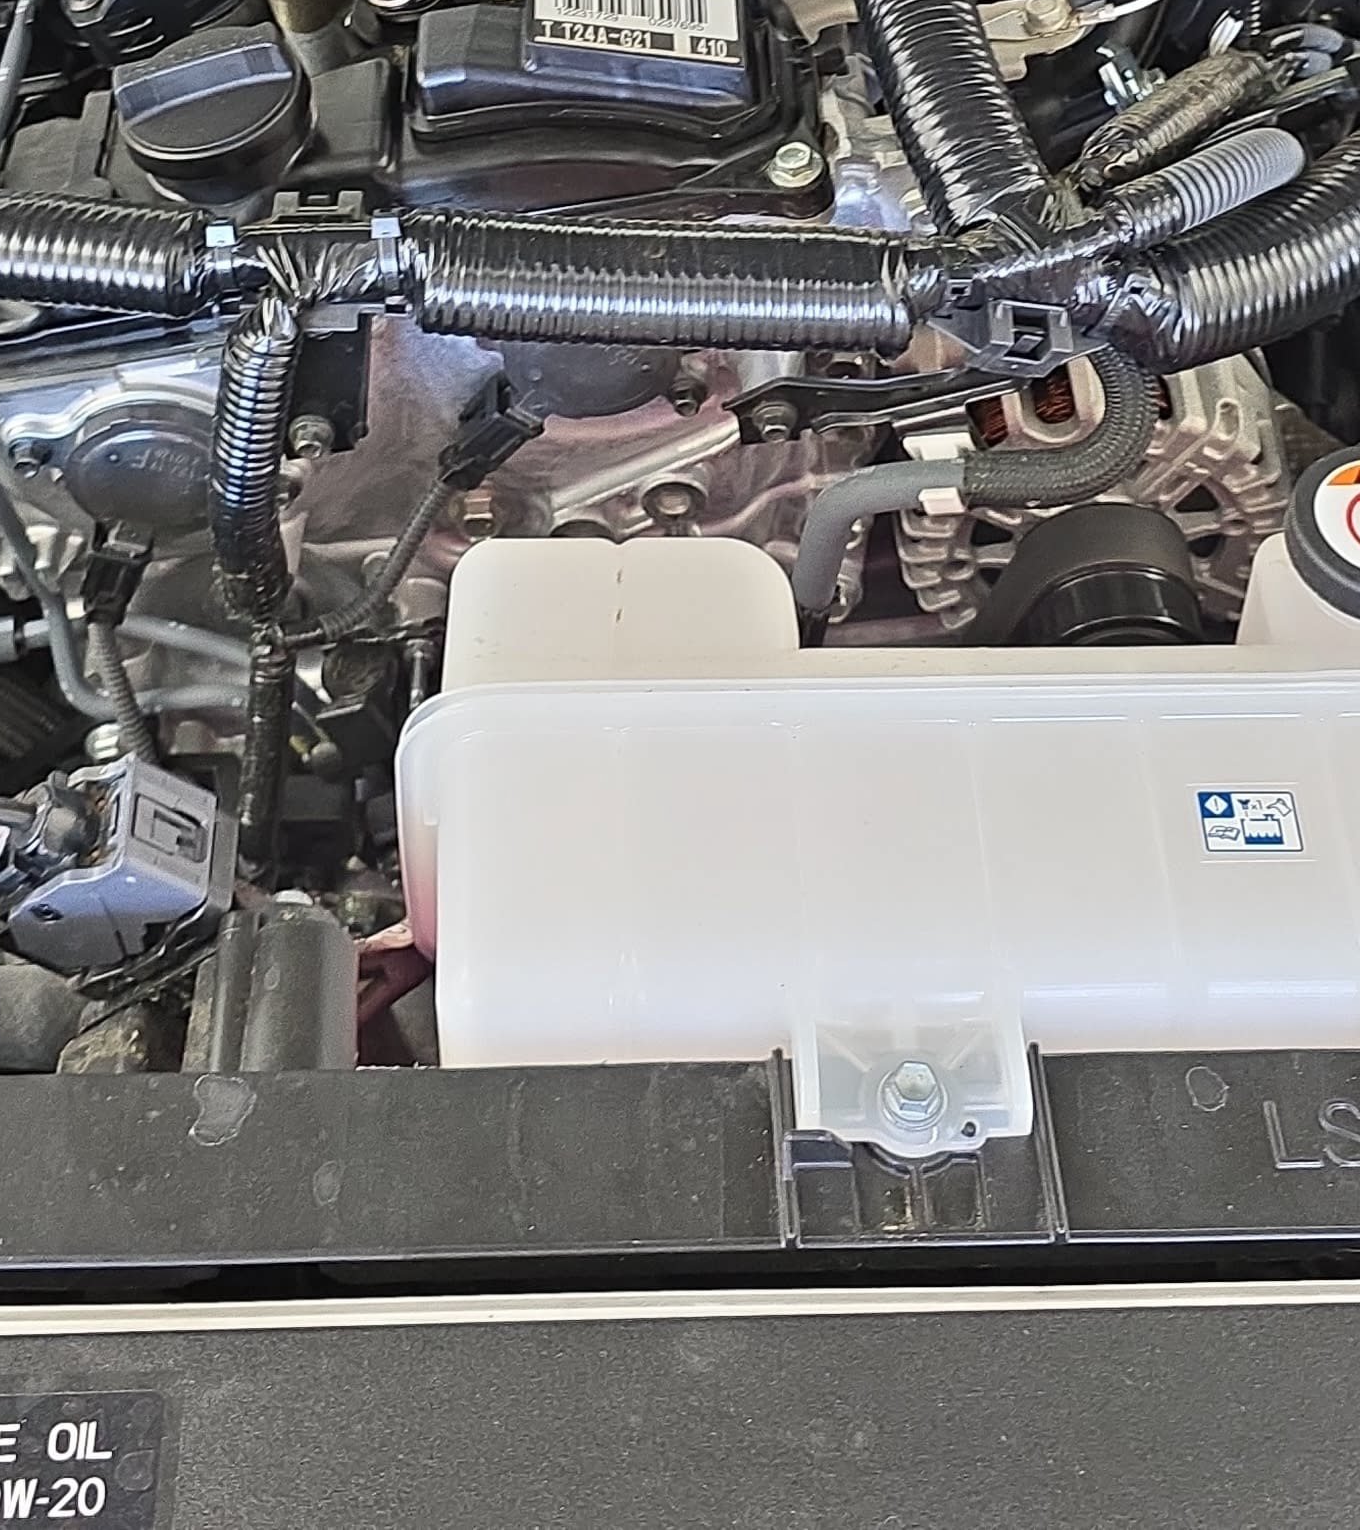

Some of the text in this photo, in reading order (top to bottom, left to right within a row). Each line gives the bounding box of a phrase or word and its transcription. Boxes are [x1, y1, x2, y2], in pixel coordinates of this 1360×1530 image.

[561, 22, 651, 49] T24A-G21
[696, 39, 728, 58] 410
[47, 1421, 113, 1462] OIL
